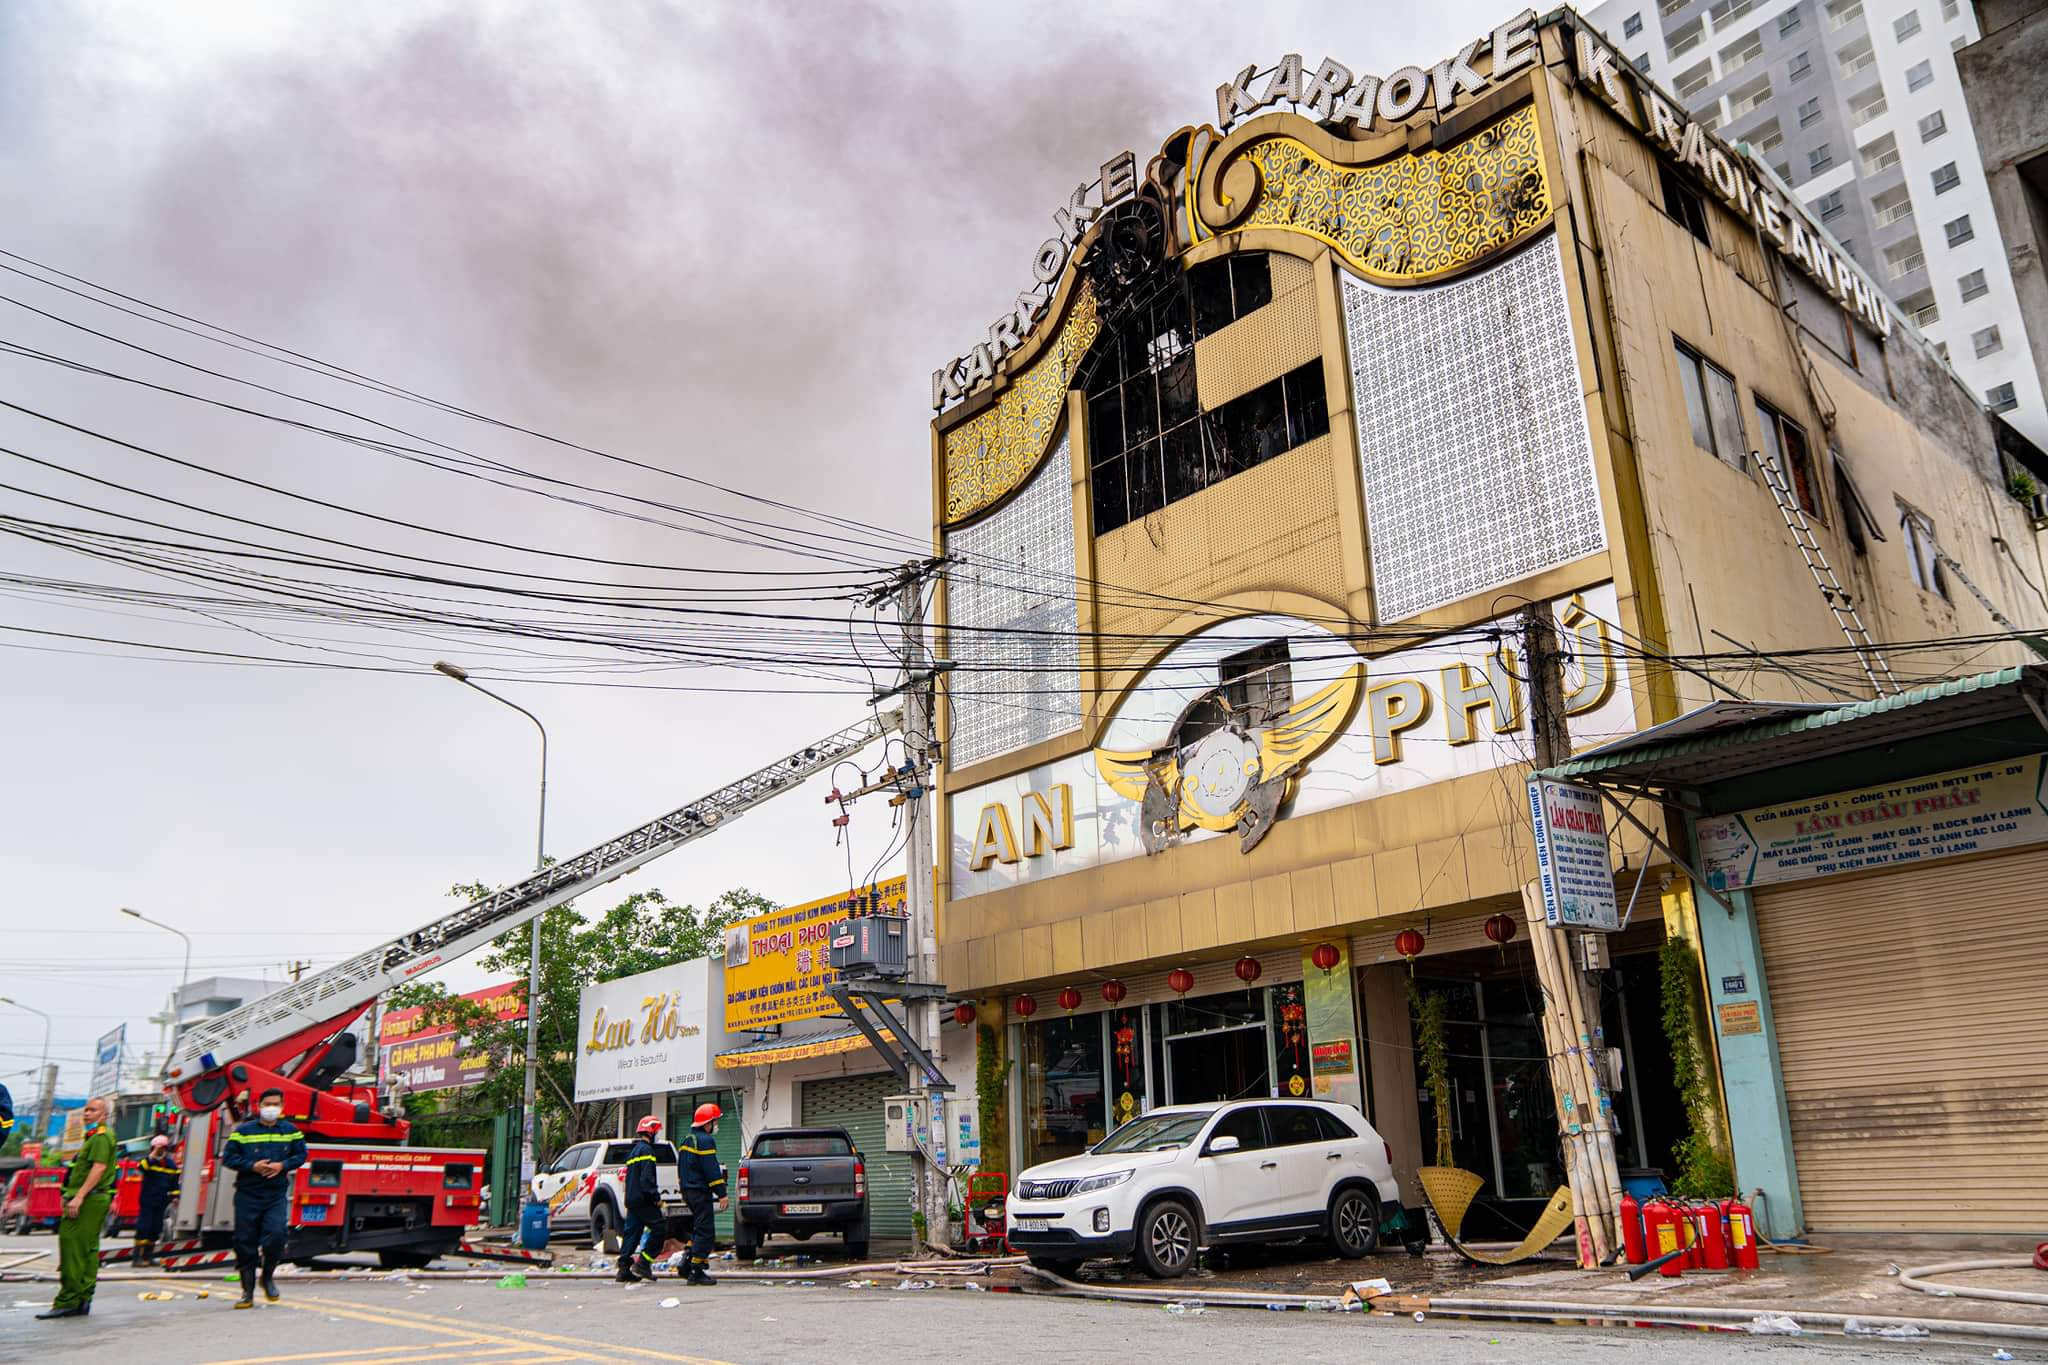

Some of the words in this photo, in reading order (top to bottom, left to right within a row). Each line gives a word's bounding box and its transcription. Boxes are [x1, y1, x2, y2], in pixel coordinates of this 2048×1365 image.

[1216, 8, 1539, 130] KARAOKE
[931, 151, 1136, 410] KARAOKE
[1833, 800, 1839, 810] 1
[1850, 788, 1885, 806] CÔNG
[1888, 788, 1902, 799] TY
[1904, 780, 1939, 796] TNHH
[1942, 773, 1971, 788] MTV
[1973, 770, 1994, 783] TM
[968, 782, 1074, 872] AN
[1762, 848, 1784, 860] MÁY
[1872, 828, 1896, 842] MÁY
[1932, 818, 1969, 833] BLOCK
[1972, 809, 1999, 825] MÁY
[1795, 812, 1844, 837] LÂM
[1847, 797, 1909, 830] CHÂU
[1837, 844, 1866, 859] CÁCH
[1908, 836, 1930, 849] GAS
[1964, 825, 1989, 840] CÁC
[769, 919, 776, 931] TY
[777, 915, 793, 929] TNHH
[807, 907, 820, 922] KIM
[820, 902, 838, 918] MING
[585, 1006, 636, 1056] Lan
